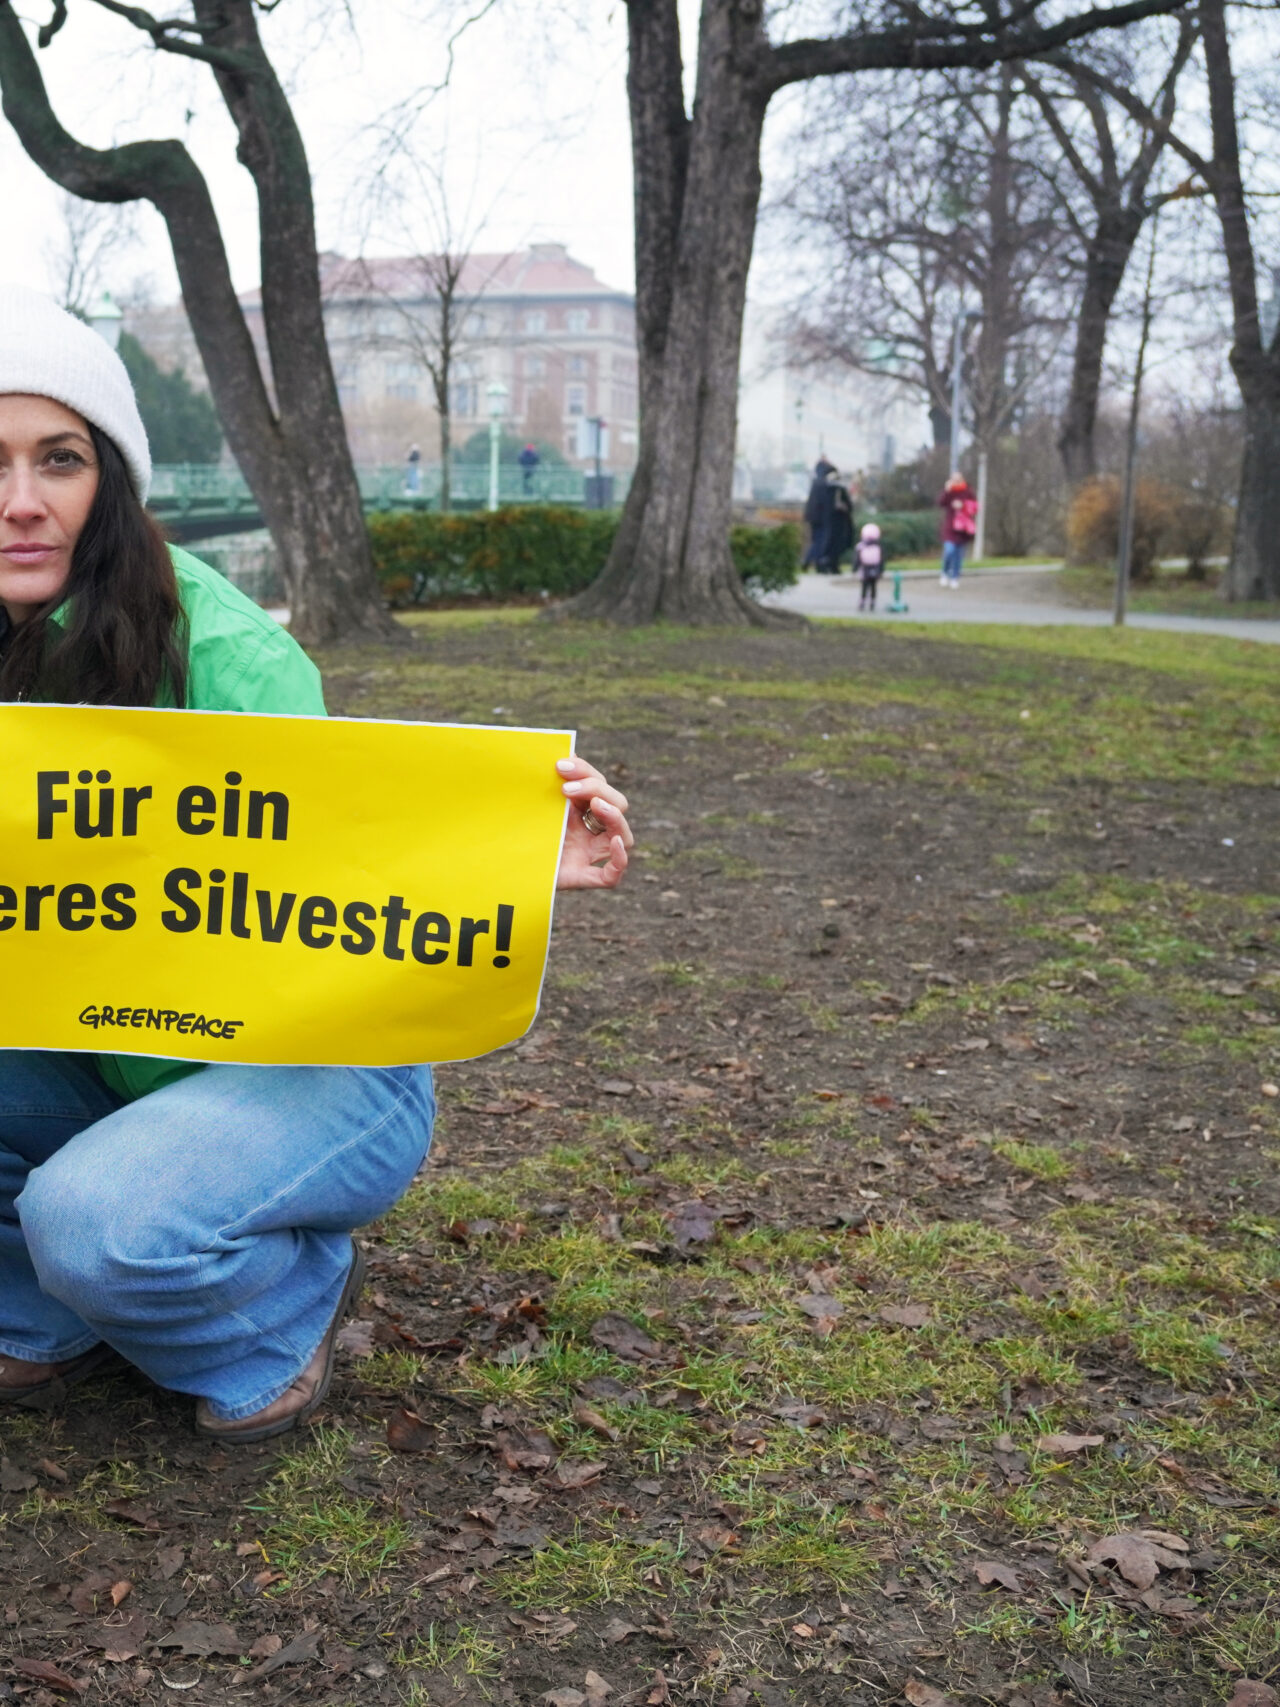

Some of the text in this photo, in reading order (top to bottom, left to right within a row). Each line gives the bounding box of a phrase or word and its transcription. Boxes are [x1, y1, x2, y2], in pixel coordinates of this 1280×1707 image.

[37, 770, 289, 841] Für ein
[160, 868, 516, 969] Silvester!
[78, 1005, 244, 1040] GREENPEACE
